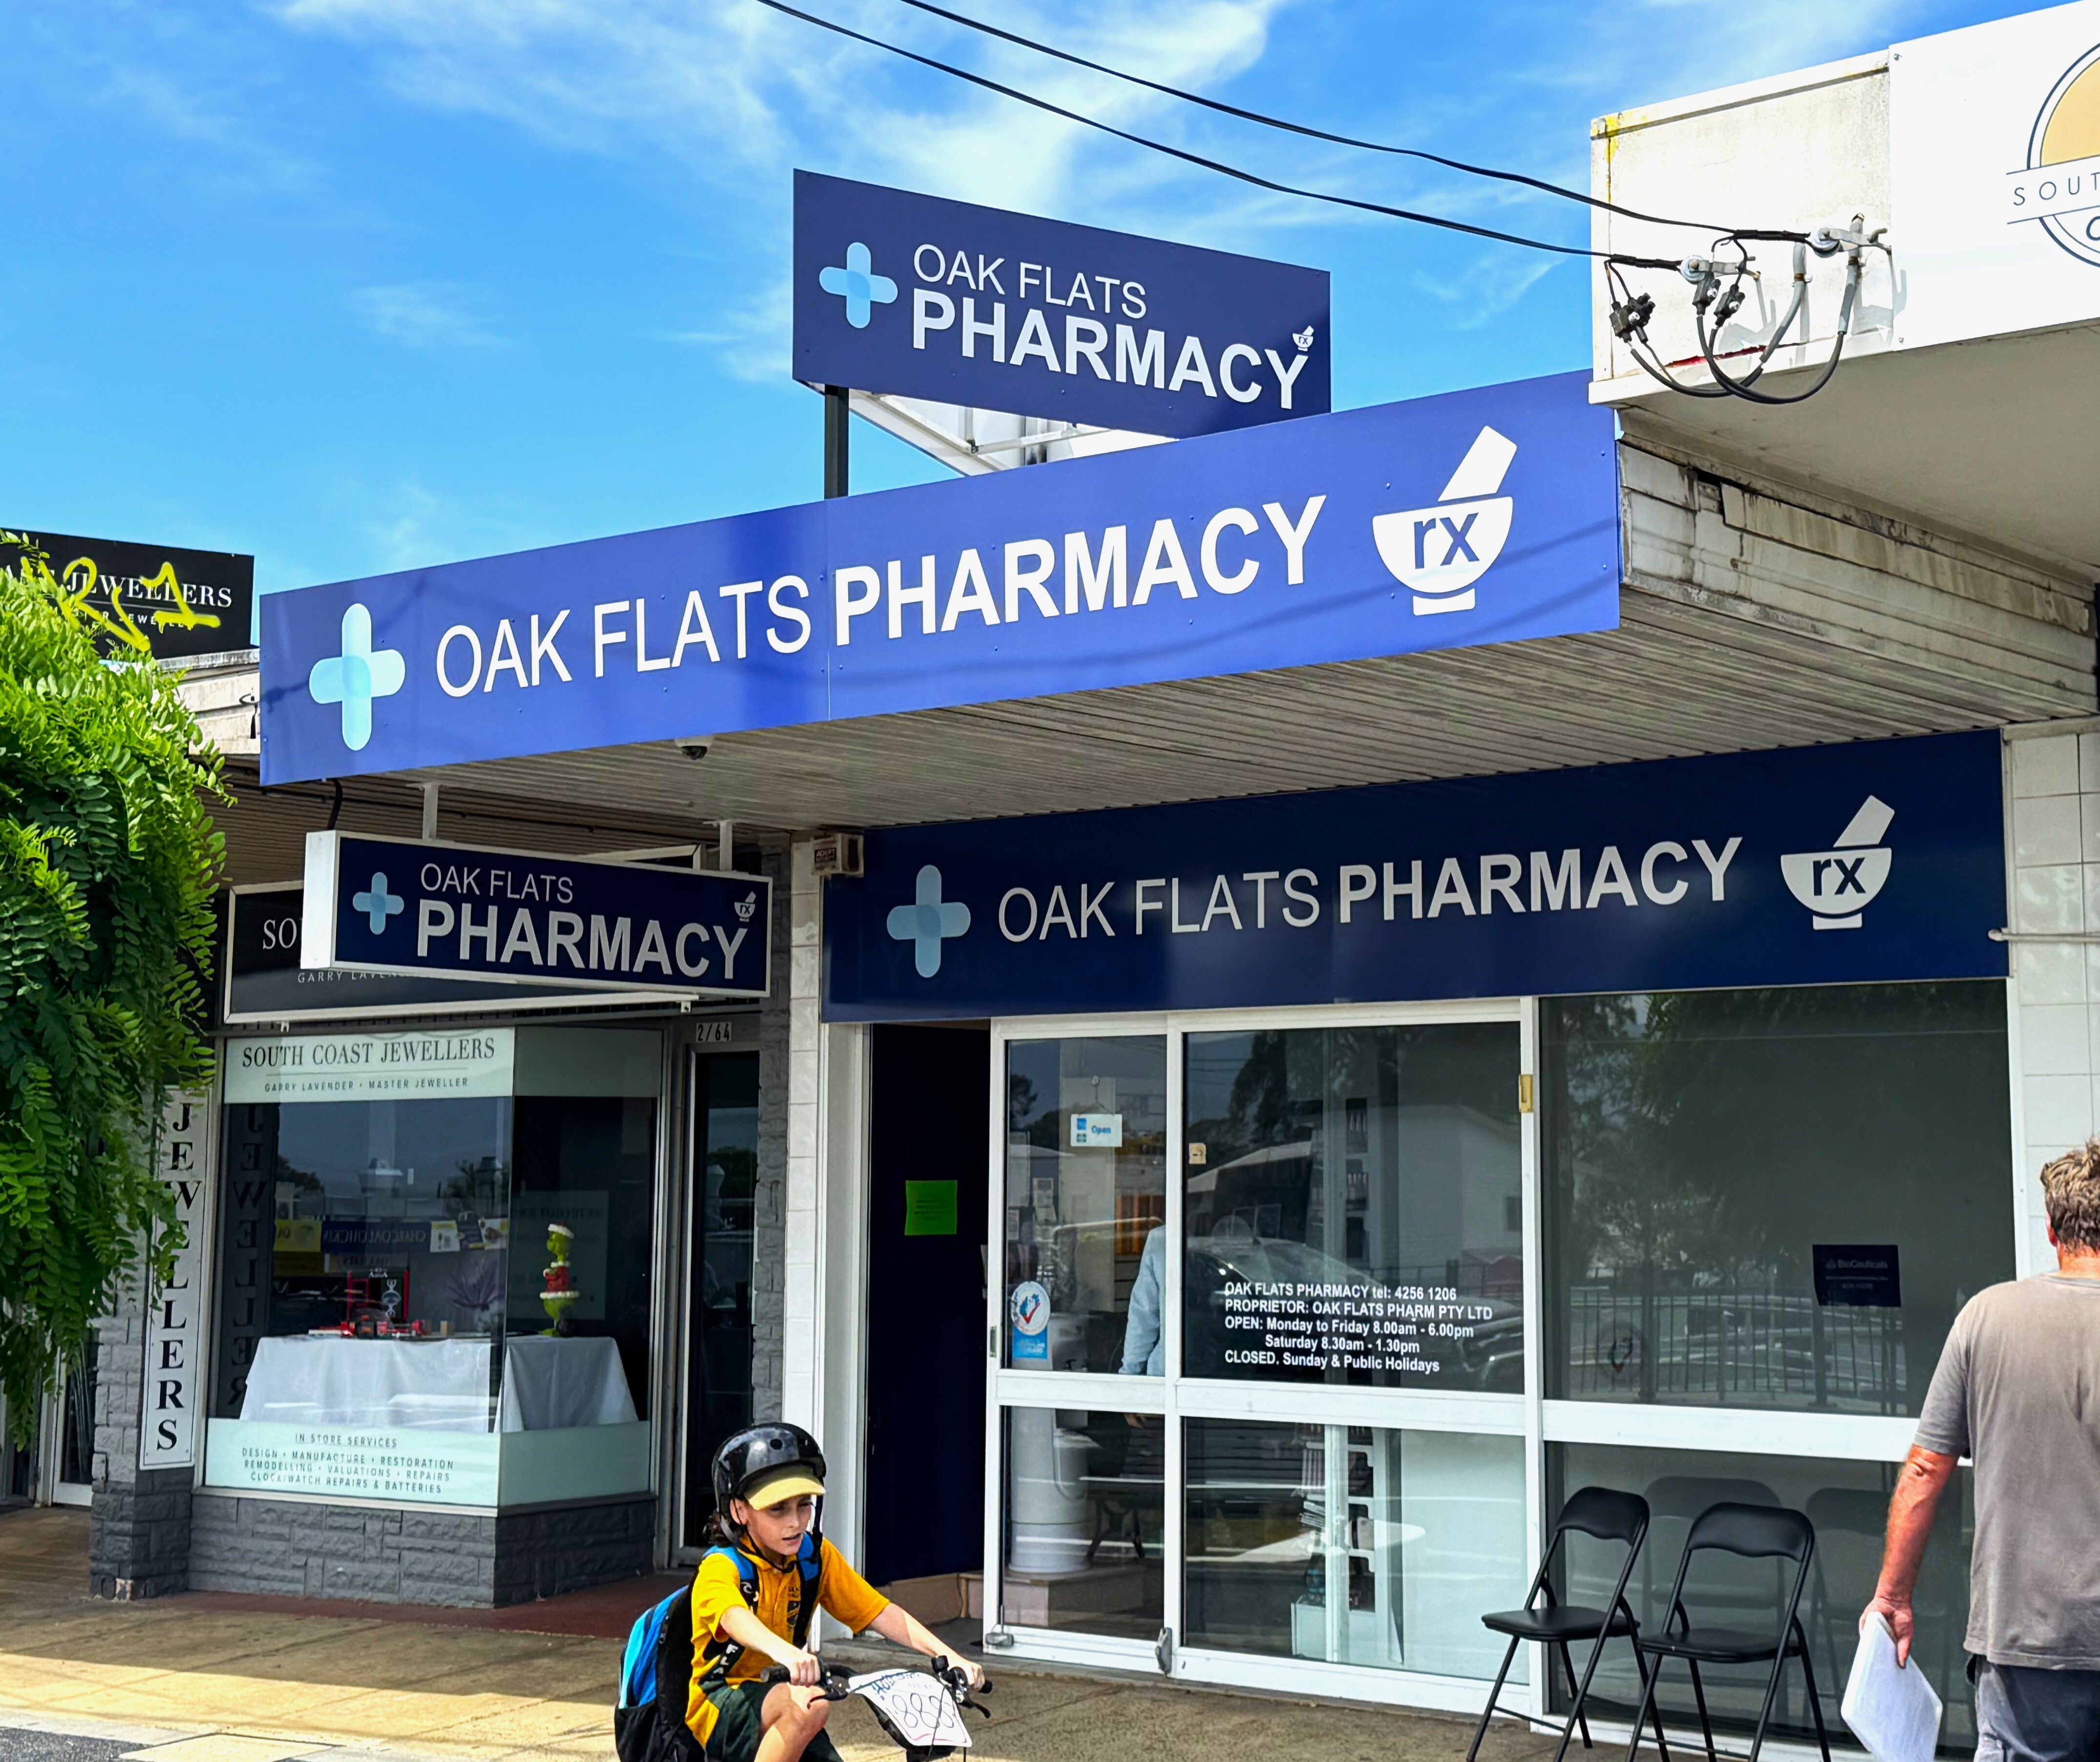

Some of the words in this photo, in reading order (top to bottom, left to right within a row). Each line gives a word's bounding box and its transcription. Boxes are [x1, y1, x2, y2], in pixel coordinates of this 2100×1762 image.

[914, 244, 1005, 294] OAK
[1020, 262, 1146, 318] FLATS
[914, 288, 1308, 409] PHARMACY
[436, 609, 572, 697] OAK
[595, 576, 810, 677] FLATS
[836, 495, 1325, 646] PHARMACY
[421, 863, 480, 896] OAK
[490, 870, 573, 903] FLATS
[999, 882, 1115, 942] OAK
[1136, 868, 1319, 934] FLATS
[1340, 837, 1742, 923] PHARMACY
[417, 899, 747, 979] PHARMACY
[698, 1024, 729, 1041] 2/64
[242, 1045, 304, 1067] SOUTH
[312, 1043, 373, 1065] COAST
[381, 1038, 495, 1063] JEWELLERS
[265, 1083, 296, 1092] GARRY
[302, 1081, 353, 1091] LAVENDER
[369, 1080, 409, 1089] MASTER
[415, 1078, 468, 1088] JEWELLER
[1091, 1125, 1112, 1135] Open
[1225, 1281, 1252, 1295] OAK
[1255, 1282, 1294, 1295] FLATS
[1297, 1283, 1369, 1297] PHARMACY
[1373, 1286, 1391, 1298] tel:
[1395, 1287, 1423, 1299] 4256
[1428, 1287, 1456, 1300] 1206
[1225, 1300, 1309, 1313] PROPRIETOR:
[1313, 1301, 1340, 1314] OAK
[1344, 1302, 1383, 1315] FLATS
[1387, 1303, 1435, 1318] PHARM
[1439, 1305, 1464, 1318] PTY
[1467, 1305, 1493, 1319] LTD
[1225, 1315, 1263, 1329] OPEN:
[1267, 1316, 1313, 1333] Monday
[1317, 1318, 1328, 1331] to
[1332, 1319, 1369, 1335] Friday
[1373, 1322, 1416, 1334] 8.00am
[1428, 1322, 1474, 1337] 6.00pm
[1265, 1333, 1318, 1351] Saturday
[1321, 1335, 1364, 1350] 8.30am
[1376, 1337, 1420, 1352] 1.30pm
[1283, 1352, 1326, 1369] Sunday
[1331, 1354, 1340, 1366] &
[1344, 1355, 1382, 1368] Public
[1386, 1356, 1440, 1373] Holidays
[296, 1434, 305, 1443] IN
[311, 1434, 341, 1445] STORE
[348, 1436, 397, 1448] SERVICES
[243, 1448, 277, 1458] DESIGN
[292, 1451, 365, 1464] MANUFACTURE
[381, 1456, 453, 1470] RESTORATION
[245, 1460, 312, 1472] REMODELLING
[328, 1464, 391, 1477] VALUATIONS
[407, 1470, 449, 1481] REPAIRS
[327, 1476, 367, 1488] REPAIRS
[374, 1480, 378, 1489] &
[385, 1481, 441, 1493] BATTERIES
